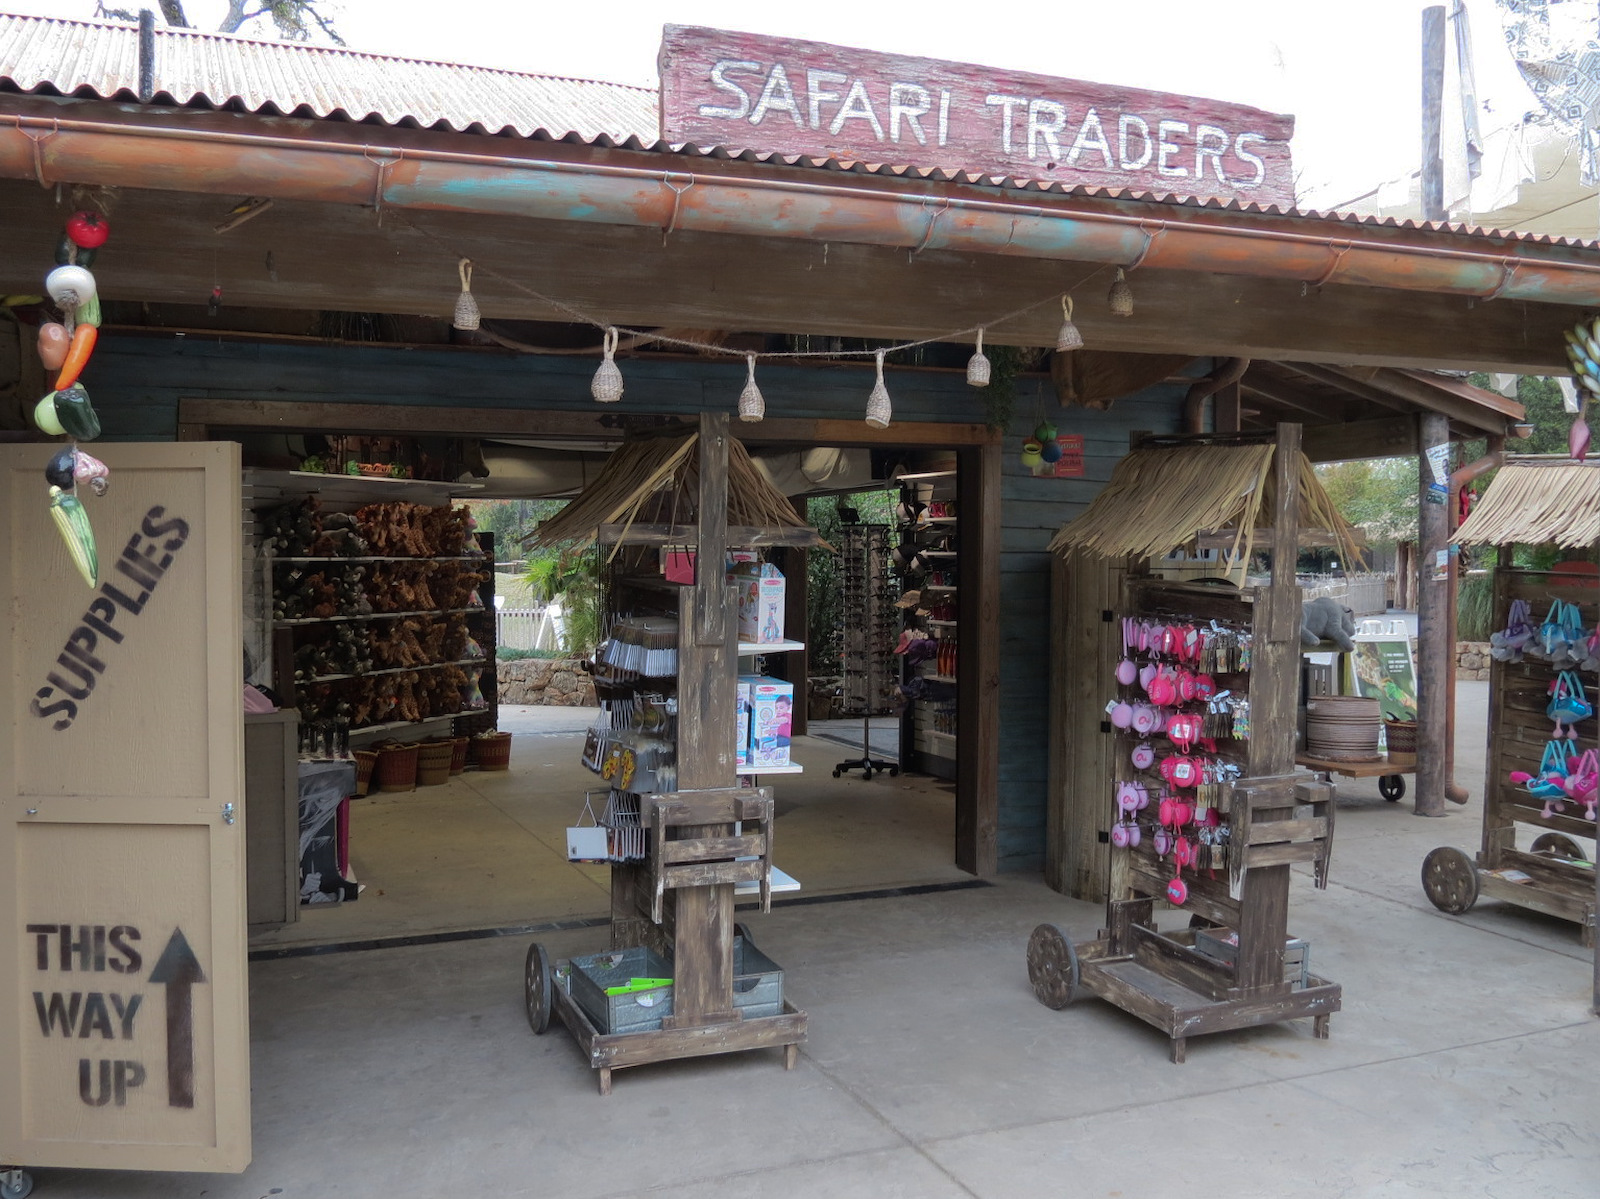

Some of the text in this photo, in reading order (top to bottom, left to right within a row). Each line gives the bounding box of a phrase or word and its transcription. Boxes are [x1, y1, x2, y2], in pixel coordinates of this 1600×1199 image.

[700, 59, 1268, 190] SAFARI TRADERS
[30, 505, 190, 731] SUPPLIES
[26, 923, 143, 974] THIS
[32, 991, 144, 1041] WAY
[79, 1058, 147, 1107] UP
